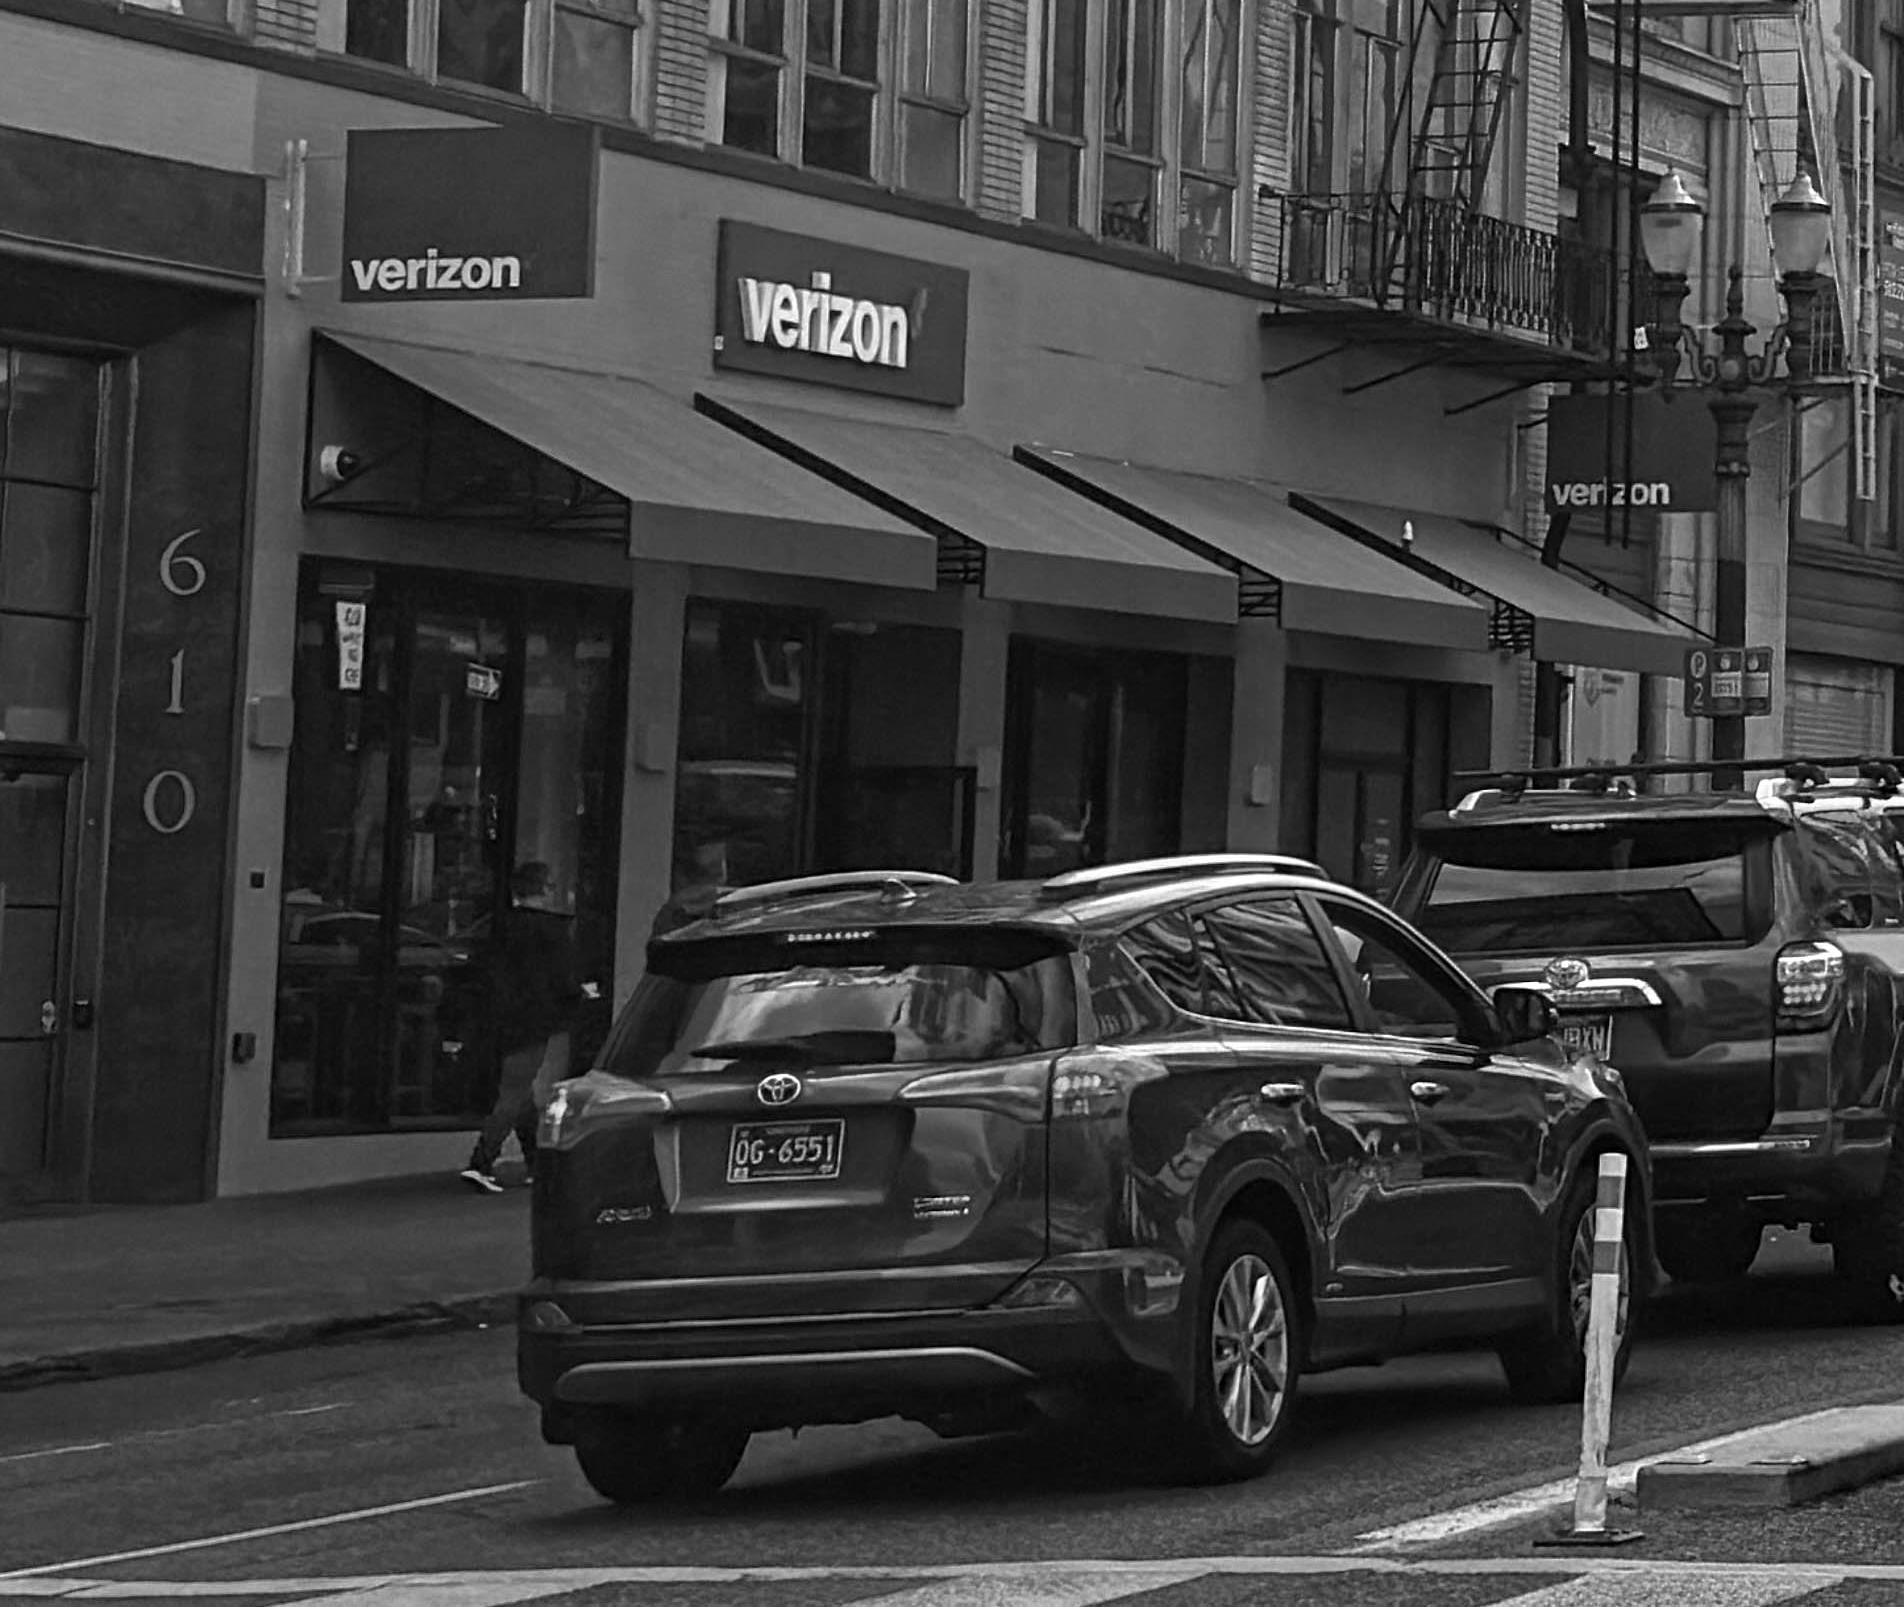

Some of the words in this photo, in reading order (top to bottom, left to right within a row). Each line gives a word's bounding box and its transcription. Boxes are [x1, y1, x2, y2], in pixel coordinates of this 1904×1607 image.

[350, 248, 521, 292] verizon
[738, 270, 909, 369] verizon
[143, 528, 207, 834] 610
